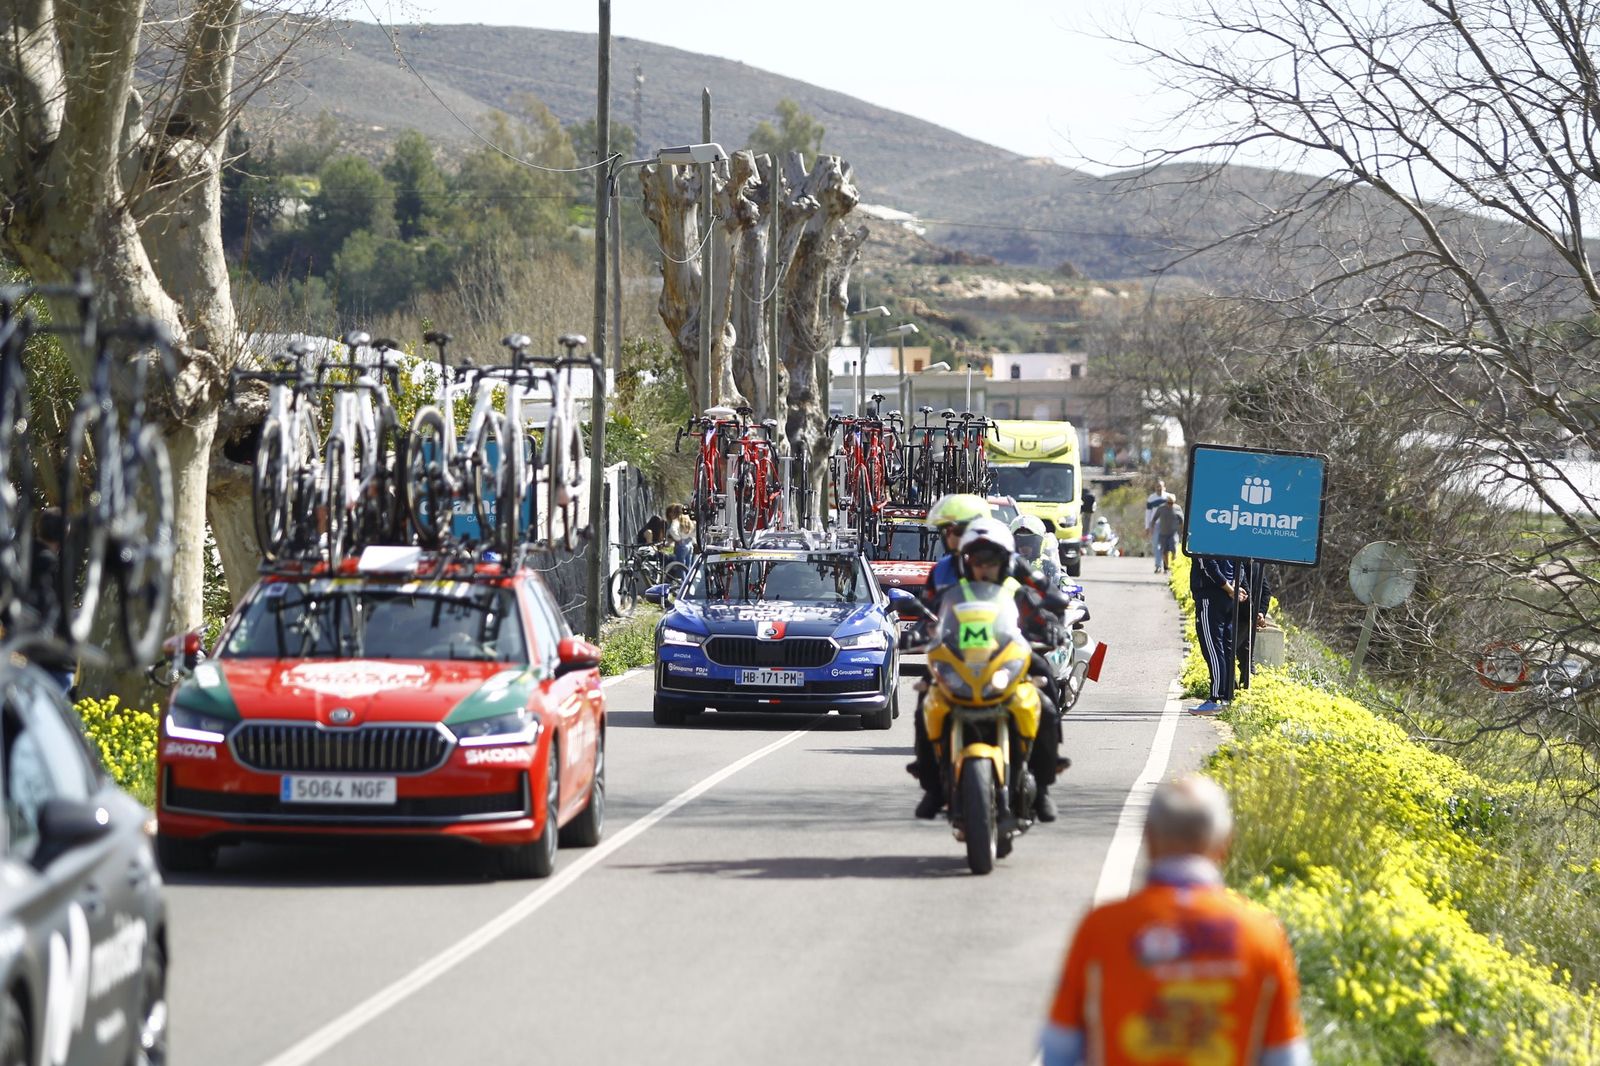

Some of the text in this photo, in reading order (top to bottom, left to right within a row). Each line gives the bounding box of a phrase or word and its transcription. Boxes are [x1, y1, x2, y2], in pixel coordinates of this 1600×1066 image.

[1205, 504, 1304, 531] cajamar
[1251, 527, 1299, 538] CAJA RURAL
[963, 626, 988, 642] M
[296, 779, 388, 798] 5064 NGF
